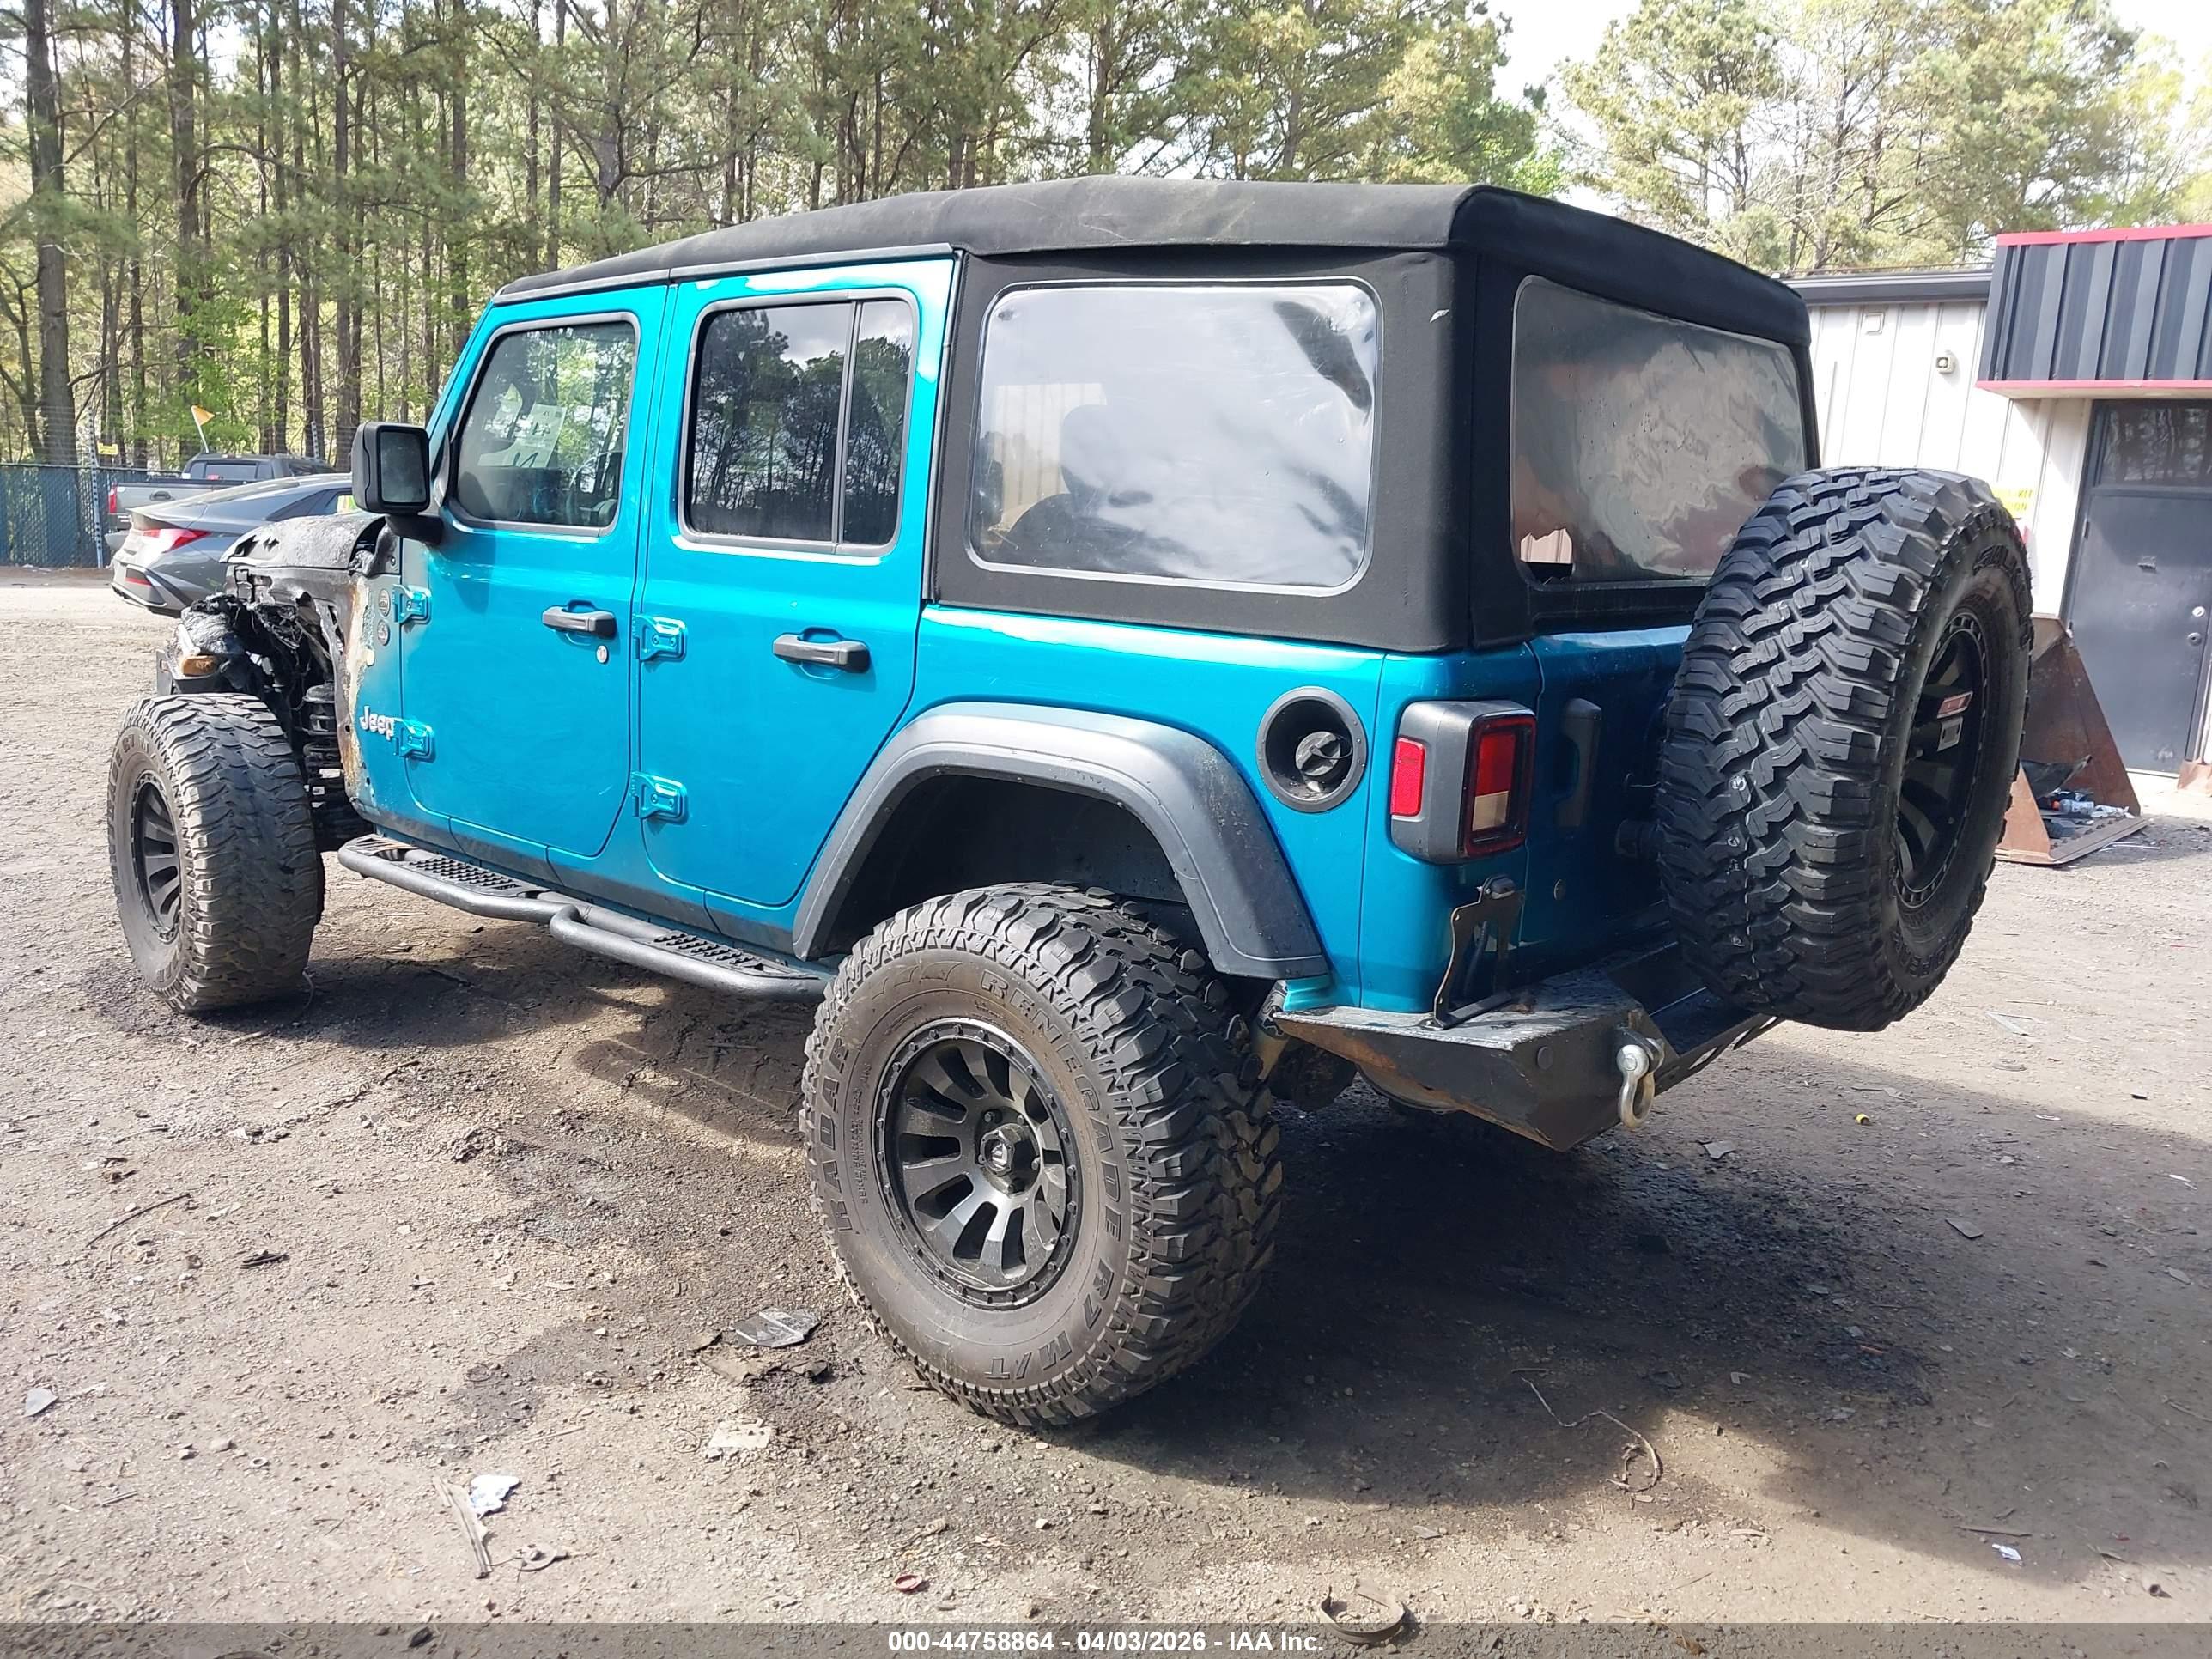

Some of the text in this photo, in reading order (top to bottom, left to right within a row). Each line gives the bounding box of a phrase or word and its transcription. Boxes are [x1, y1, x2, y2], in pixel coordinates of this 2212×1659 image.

[359, 705, 395, 741] Jeep
[819, 1036, 853, 1231] RADAR
[981, 969, 1122, 1242] RENEGADE
[1079, 1260, 1117, 1328] R7
[981, 1334, 1075, 1382] M/T
